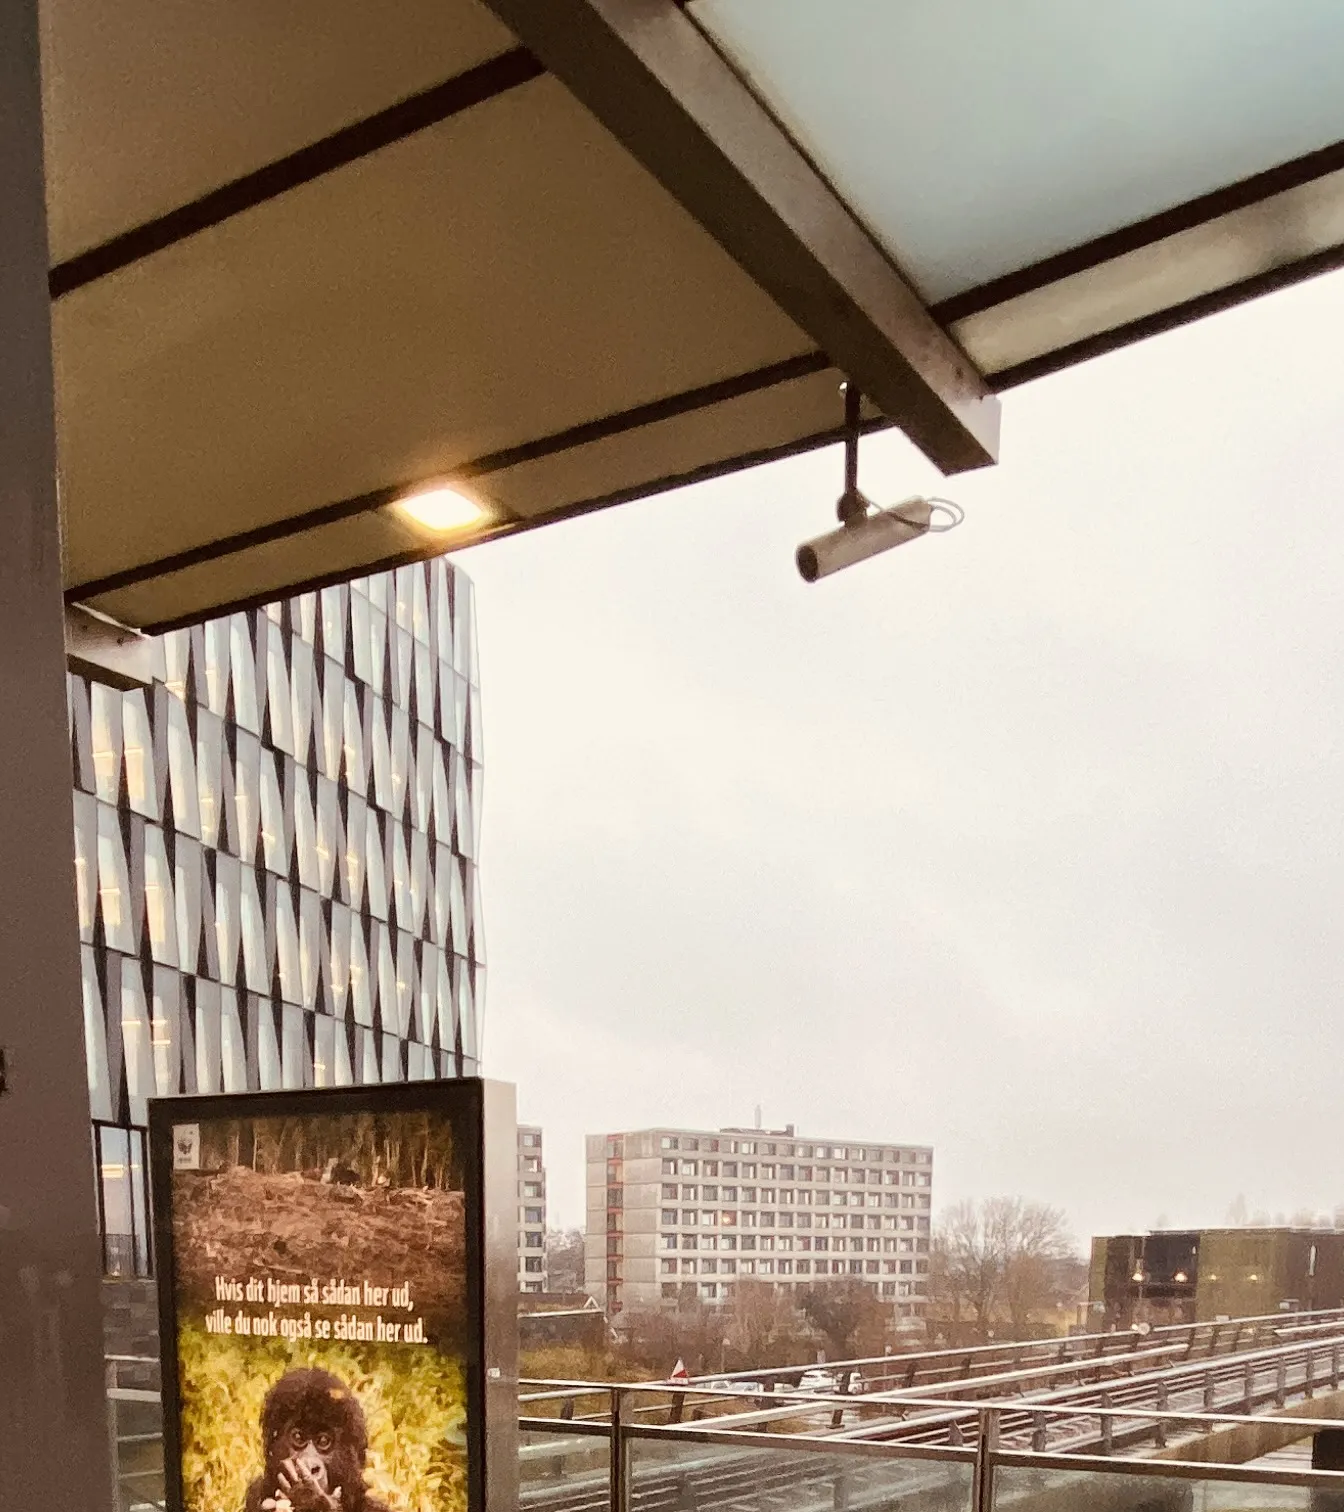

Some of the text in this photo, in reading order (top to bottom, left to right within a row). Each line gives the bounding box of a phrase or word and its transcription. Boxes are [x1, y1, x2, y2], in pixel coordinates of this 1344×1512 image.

[215, 1275, 414, 1312] Hvis dit hjem så sådan her ud,
[205, 1308, 428, 1343] ville du nok også se sådan her ud.
